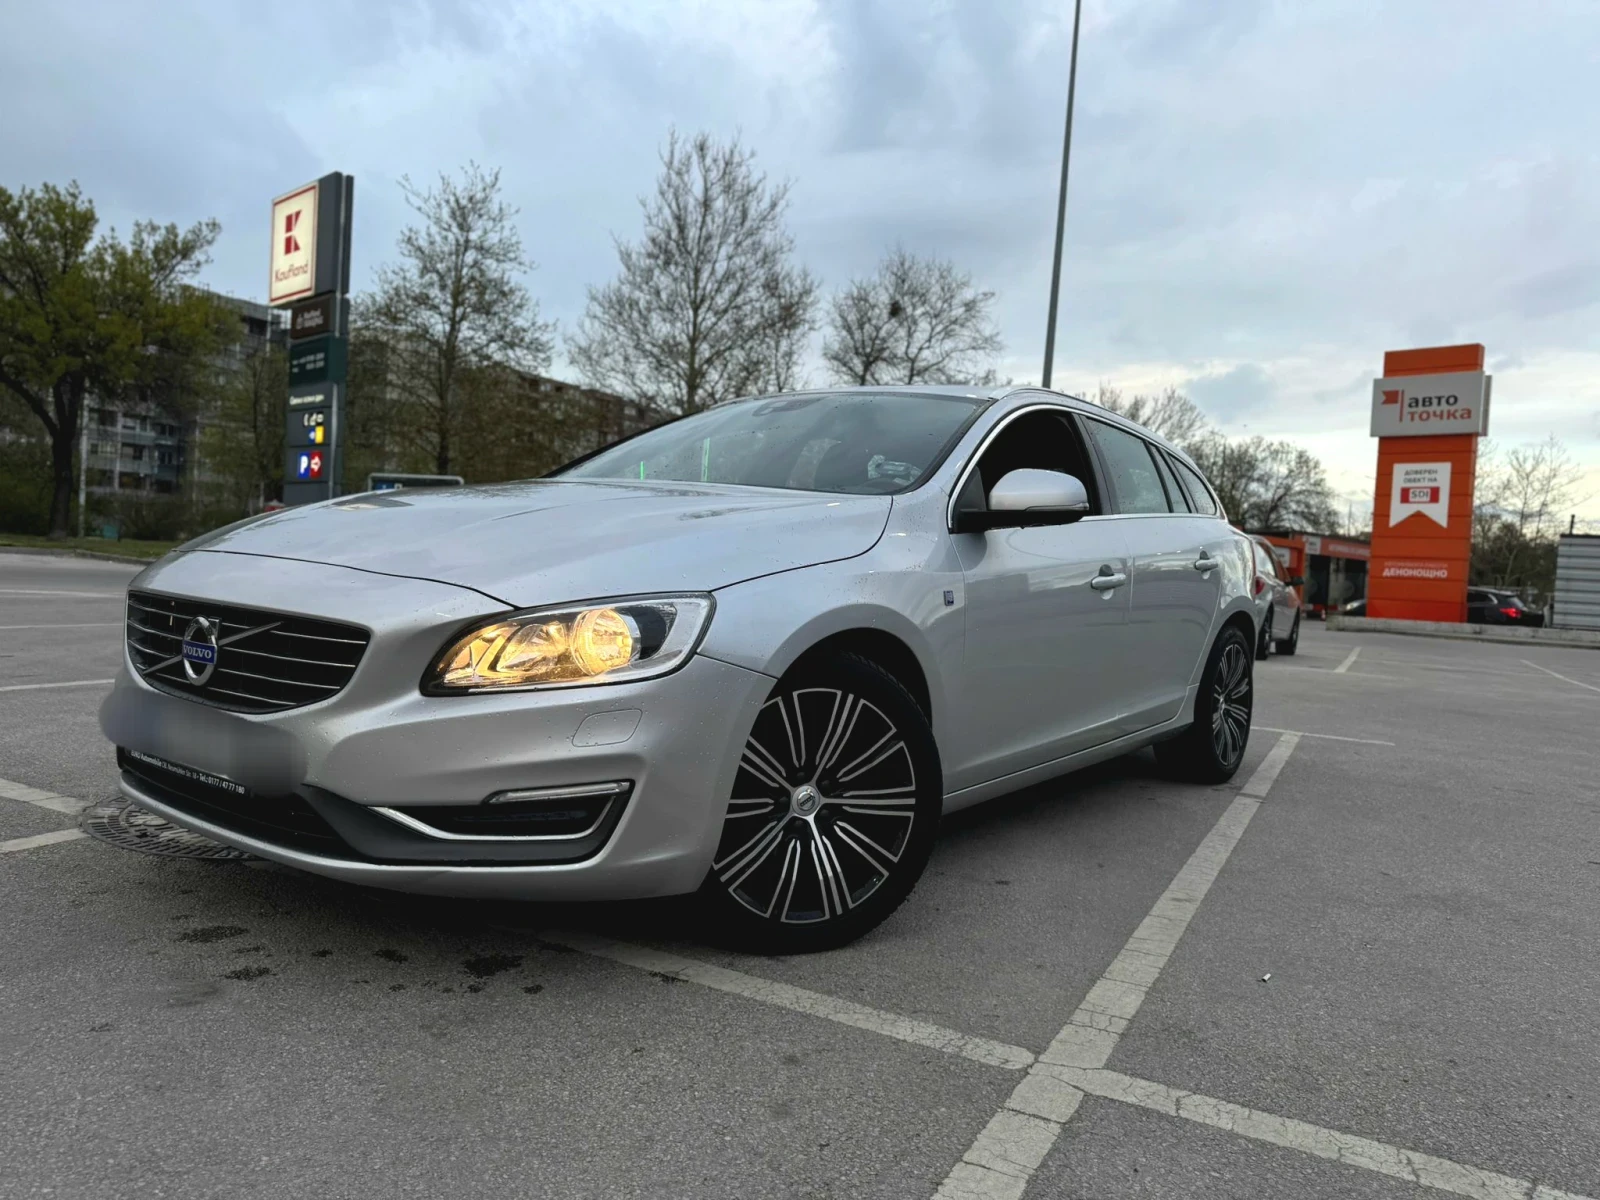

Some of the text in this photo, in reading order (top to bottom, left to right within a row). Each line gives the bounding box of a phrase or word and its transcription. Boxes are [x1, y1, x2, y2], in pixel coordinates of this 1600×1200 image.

[284, 210, 302, 255] K
[275, 261, 309, 282] Kaufland
[1408, 394, 1459, 409] авто
[1408, 408, 1472, 423] точка
[300, 455, 309, 474] P
[1411, 490, 1429, 499] SDI
[1383, 567, 1448, 579] ДЕНОНОЩНО
[183, 645, 212, 659] VOLVO
[208, 776, 220, 786] 0177
[228, 783, 236, 791] 77
